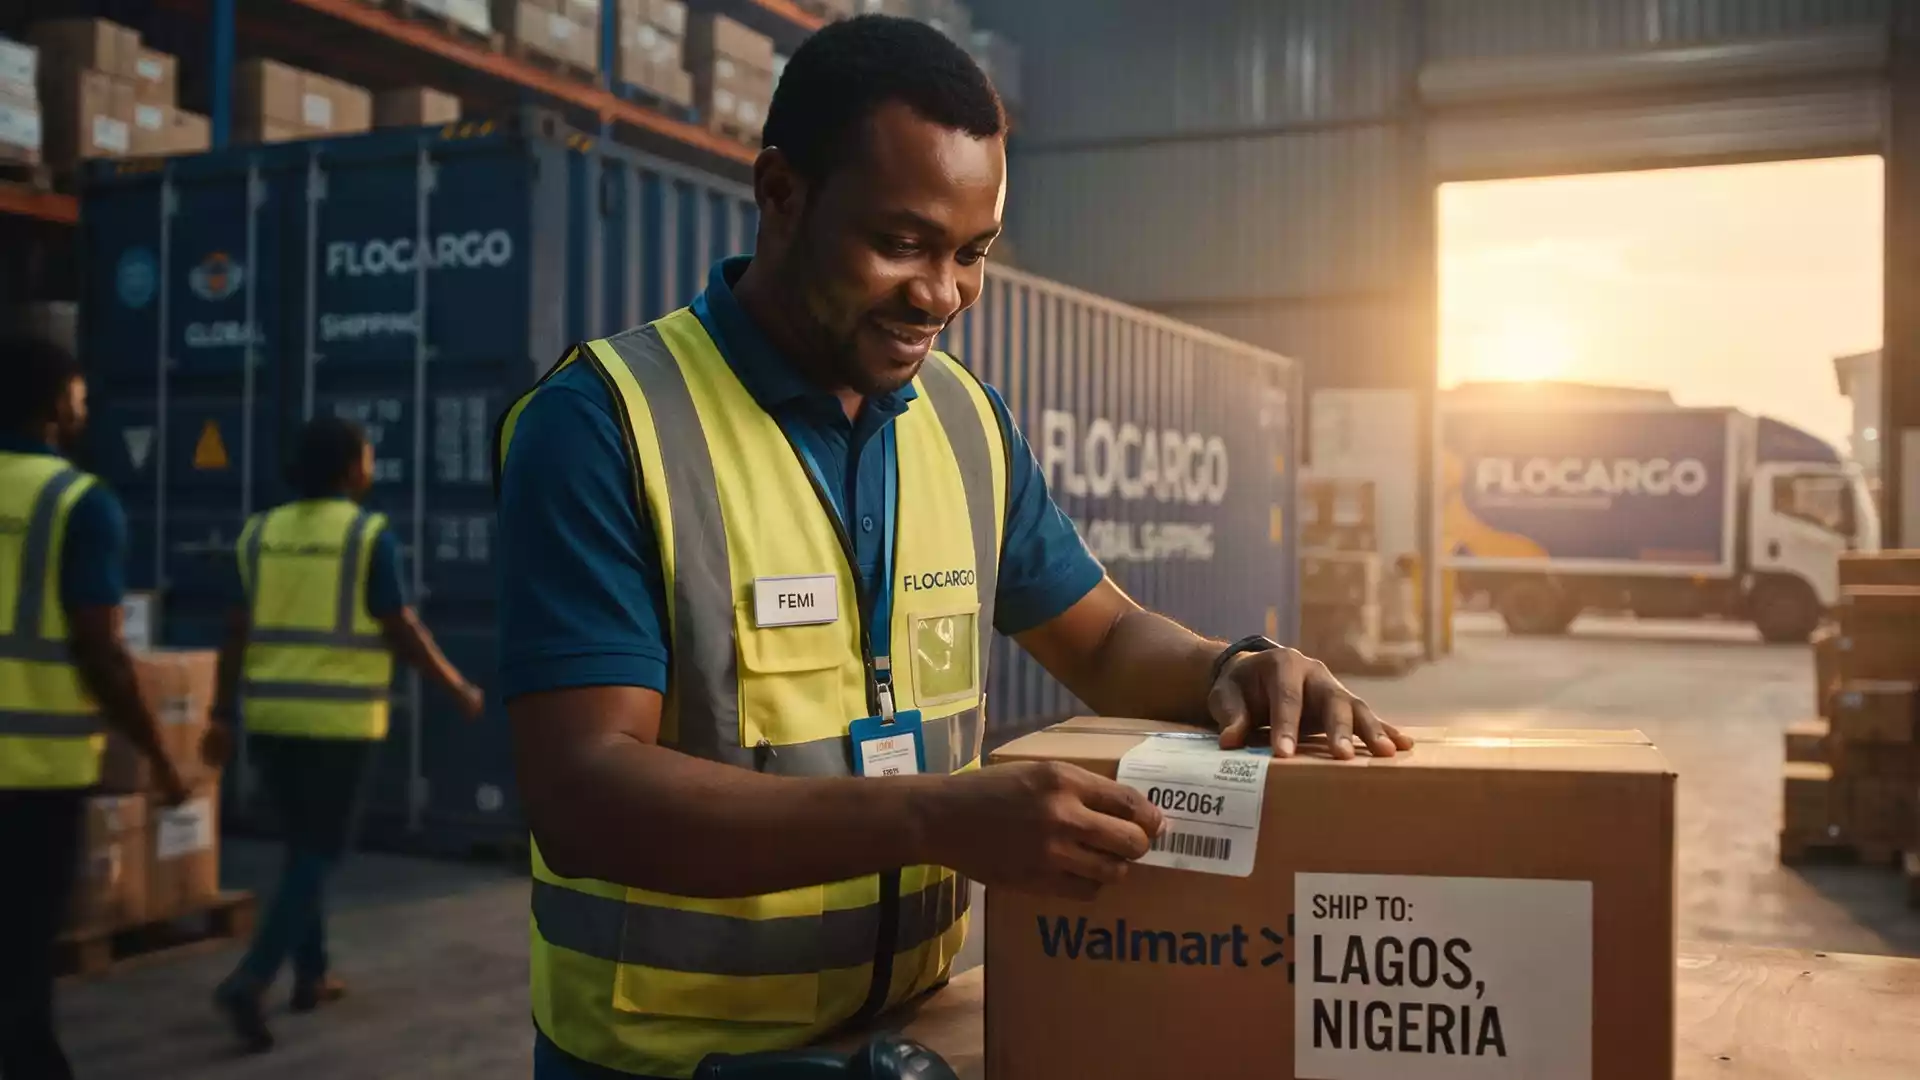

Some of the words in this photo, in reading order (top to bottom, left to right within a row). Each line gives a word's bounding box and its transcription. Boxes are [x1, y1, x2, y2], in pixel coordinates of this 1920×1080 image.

[326, 229, 512, 276] FLOCARGO
[1043, 409, 1228, 504] FLOCARGO
[1475, 457, 1707, 496] FLOCARGO
[778, 592, 814, 609] FEMI
[903, 569, 975, 592] FLOCARGO
[1311, 893, 1368, 921] SHIP
[1375, 896, 1414, 922] TO:
[1037, 914, 1249, 967] Walmart
[1312, 934, 1486, 999] LAGOS,
[1312, 997, 1508, 1057] NIGERIA
